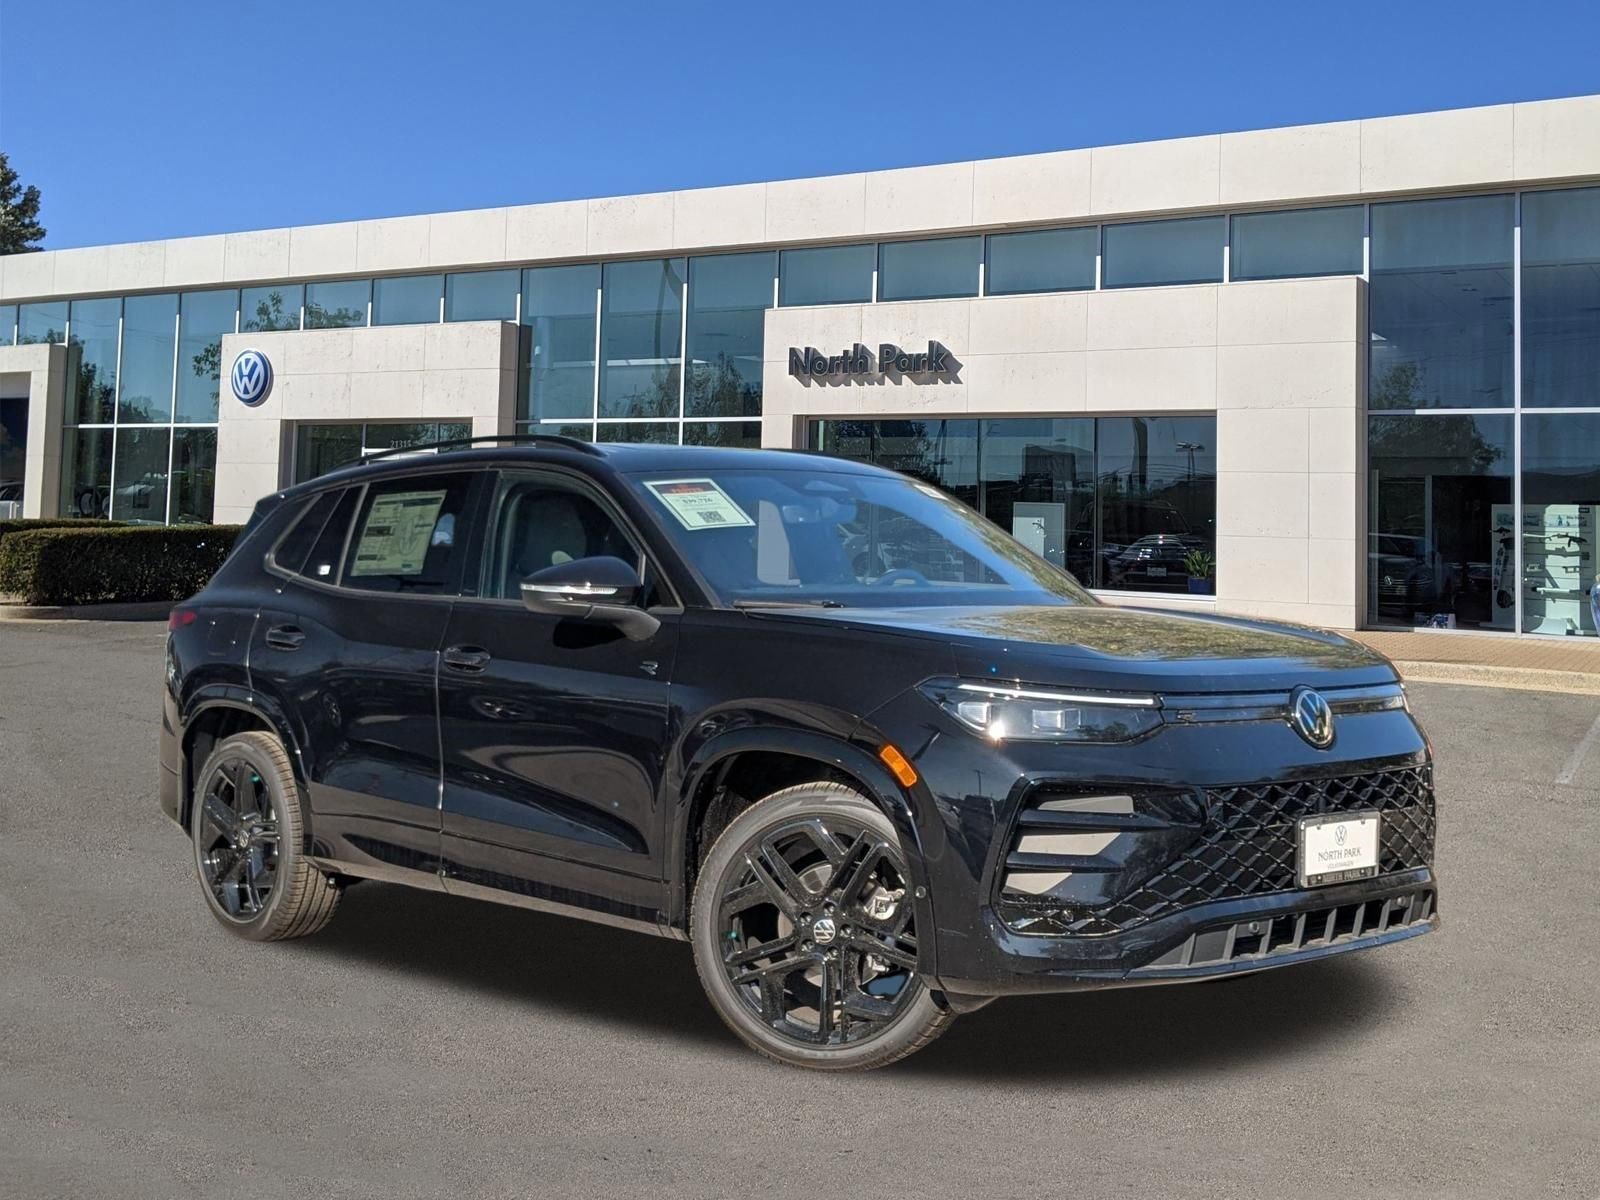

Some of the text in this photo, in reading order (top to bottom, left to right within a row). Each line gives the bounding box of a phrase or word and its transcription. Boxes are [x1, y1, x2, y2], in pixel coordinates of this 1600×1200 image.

[788, 340, 948, 376] North Park
[1317, 847, 1362, 862] NORTH PARK
